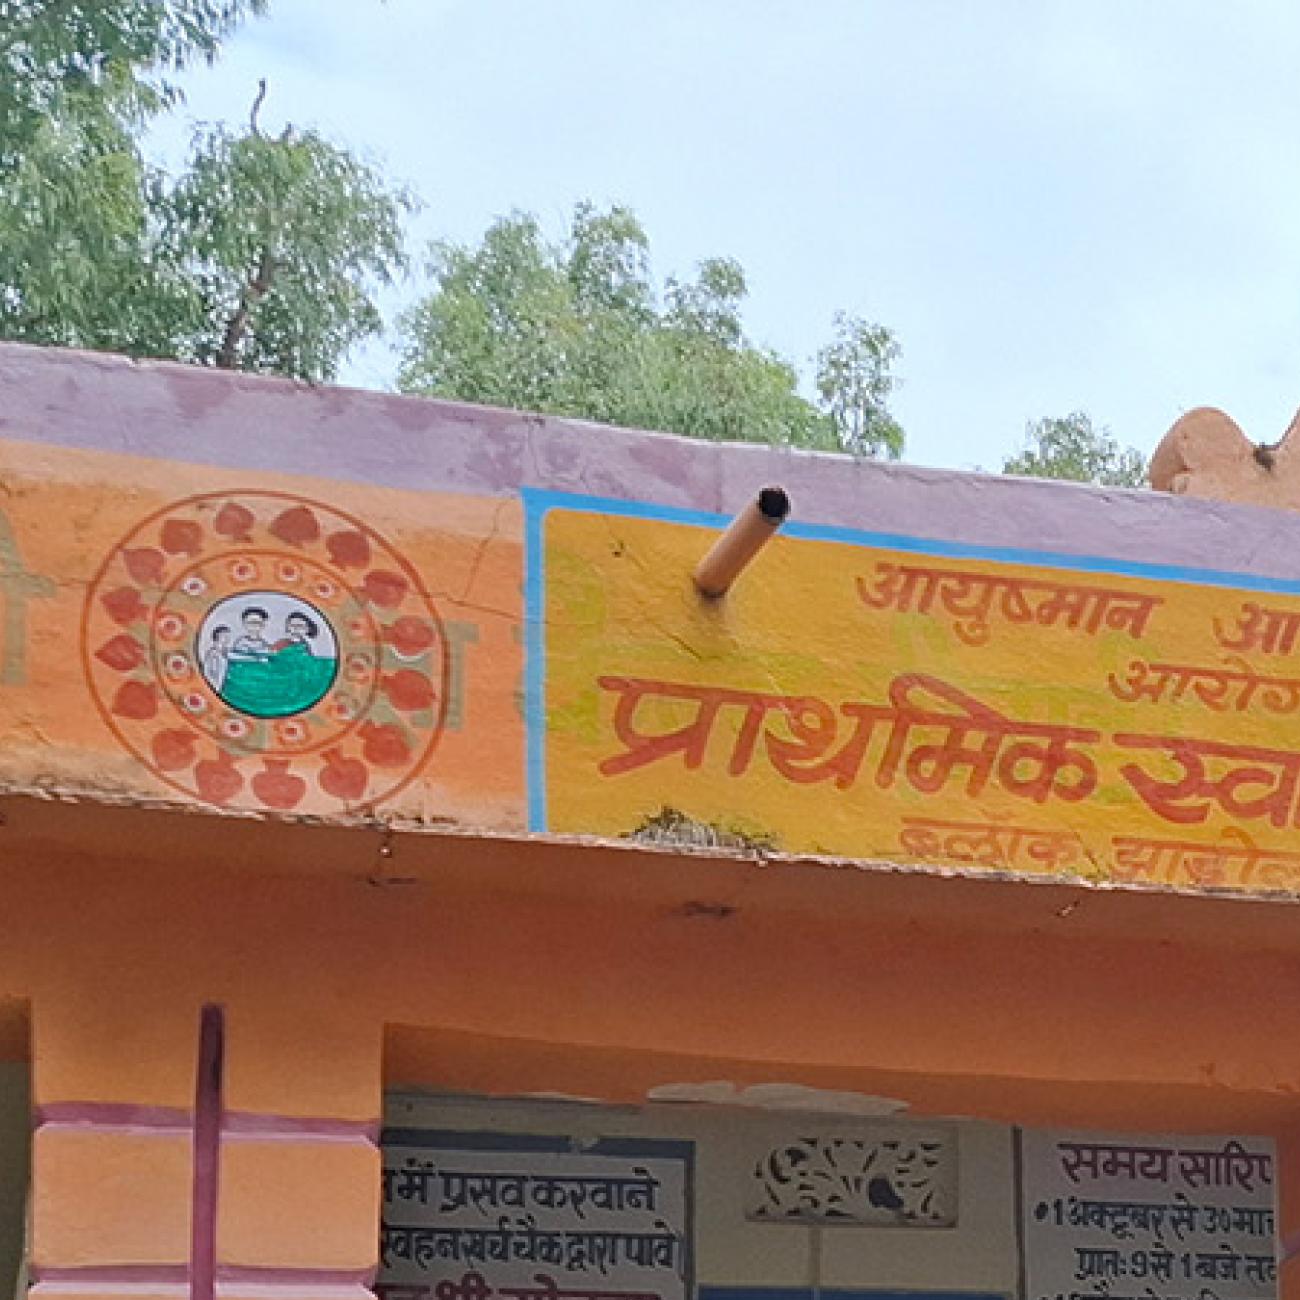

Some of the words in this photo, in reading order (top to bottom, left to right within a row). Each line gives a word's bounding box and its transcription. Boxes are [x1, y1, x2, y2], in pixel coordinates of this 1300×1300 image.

[856, 560, 1165, 648] आयुष्मान
[597, 672, 1102, 803] प्राथमिक
[529, 1166, 660, 1220] करवाने
[1057, 1143, 1174, 1184] समय
